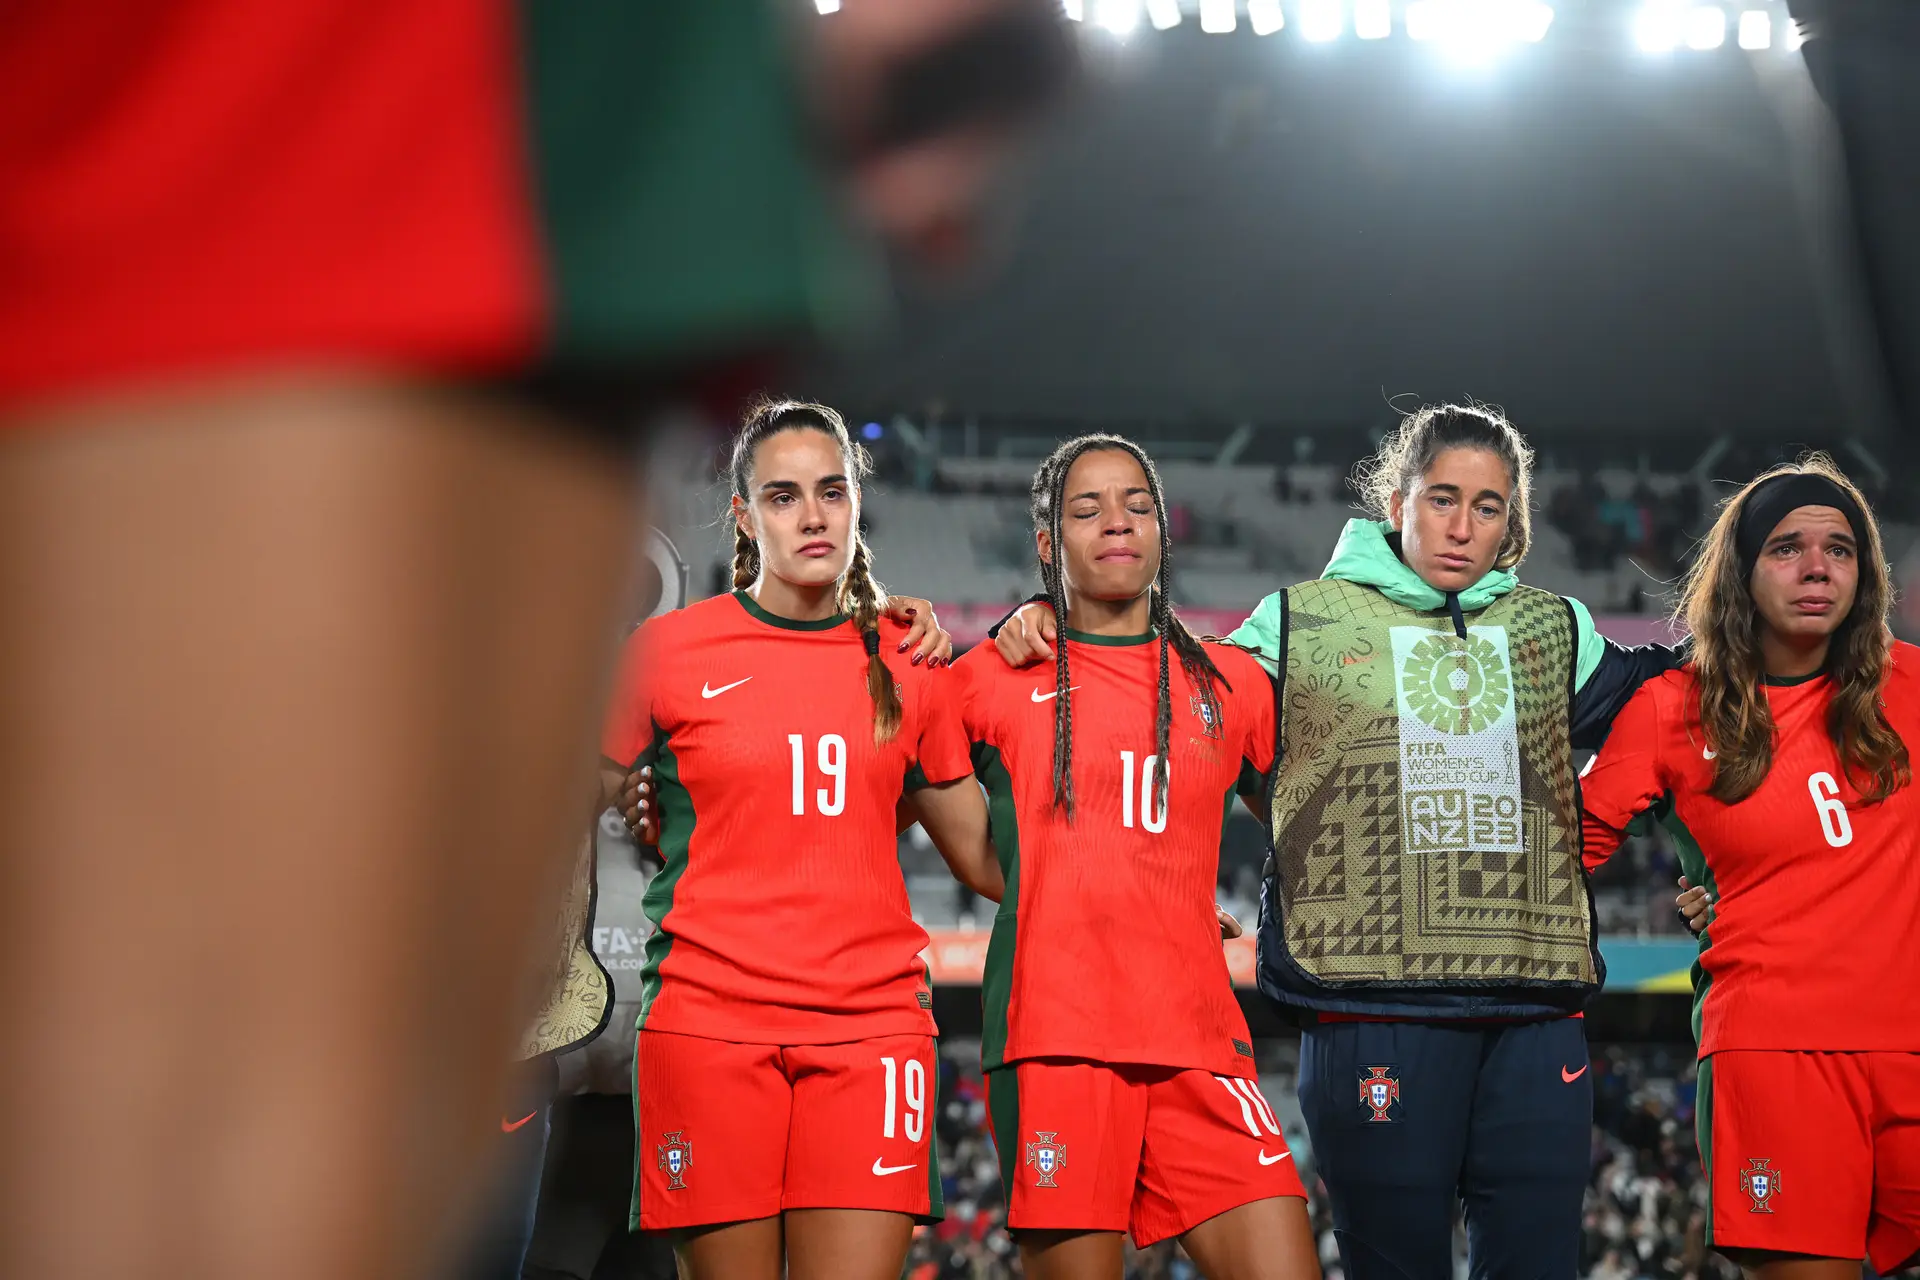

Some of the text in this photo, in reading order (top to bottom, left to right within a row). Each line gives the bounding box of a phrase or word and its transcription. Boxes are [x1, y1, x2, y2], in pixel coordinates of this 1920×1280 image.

[1406, 742, 1447, 756] FIFA
[788, 733, 847, 816] 19
[1407, 757, 1485, 770] WOMEN'S
[1408, 771, 1500, 785] WORLD CUP
[1120, 750, 1170, 833] 10
[1411, 794, 1462, 819] AU
[1472, 793, 1517, 819] 20
[1808, 771, 1853, 847] 6
[1413, 819, 1465, 845] NZ
[1473, 820, 1519, 845] 23
[592, 927, 633, 954] FA
[880, 1057, 925, 1143] 19
[1214, 1076, 1280, 1136] 10
